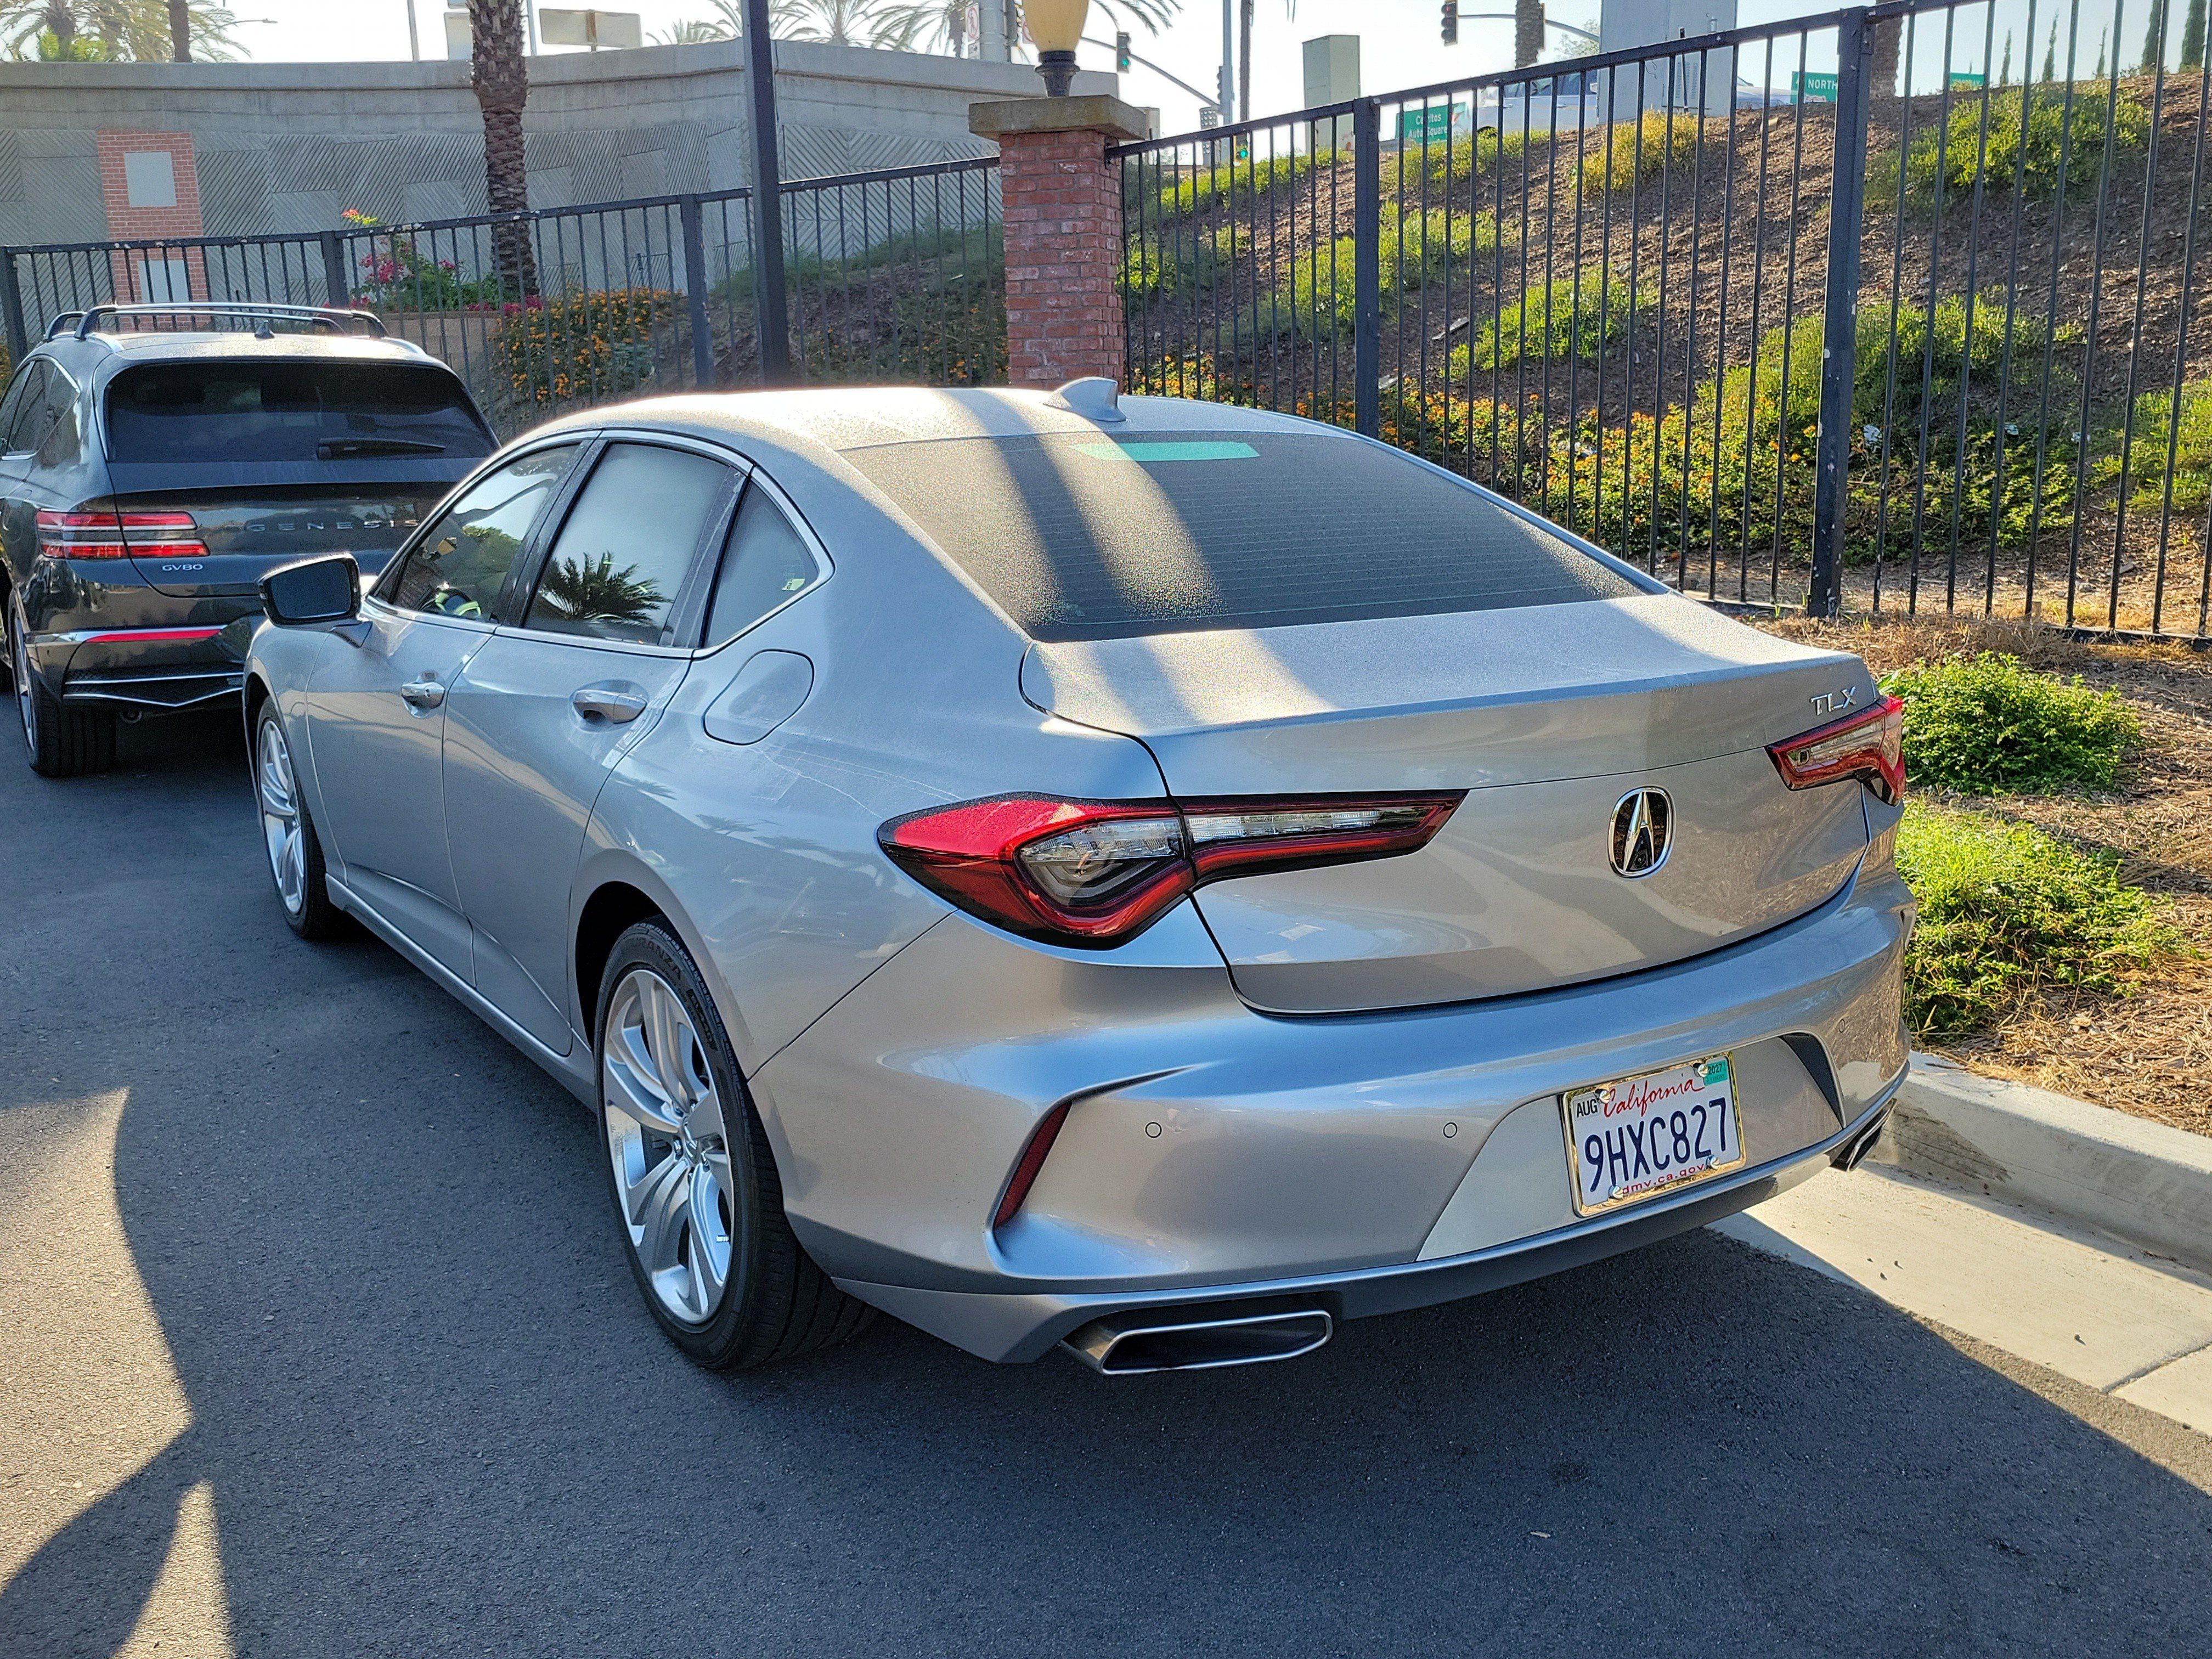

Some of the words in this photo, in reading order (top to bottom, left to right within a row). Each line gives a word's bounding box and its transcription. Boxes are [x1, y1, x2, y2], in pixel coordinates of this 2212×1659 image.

[1808, 78, 1838, 90] NORTH
[1416, 114, 1441, 125] Ceitos
[1408, 128, 1424, 138] Auto
[247, 520, 419, 532] GENESIS
[1809, 686, 1858, 716] TLX
[1707, 1062, 1723, 1075] 2027
[1576, 1098, 1599, 1118] AUG
[1604, 1079, 1705, 1118] California
[1584, 1097, 1727, 1193] 9HXC827
[1622, 1164, 1705, 1194] dmv.ca.gov
